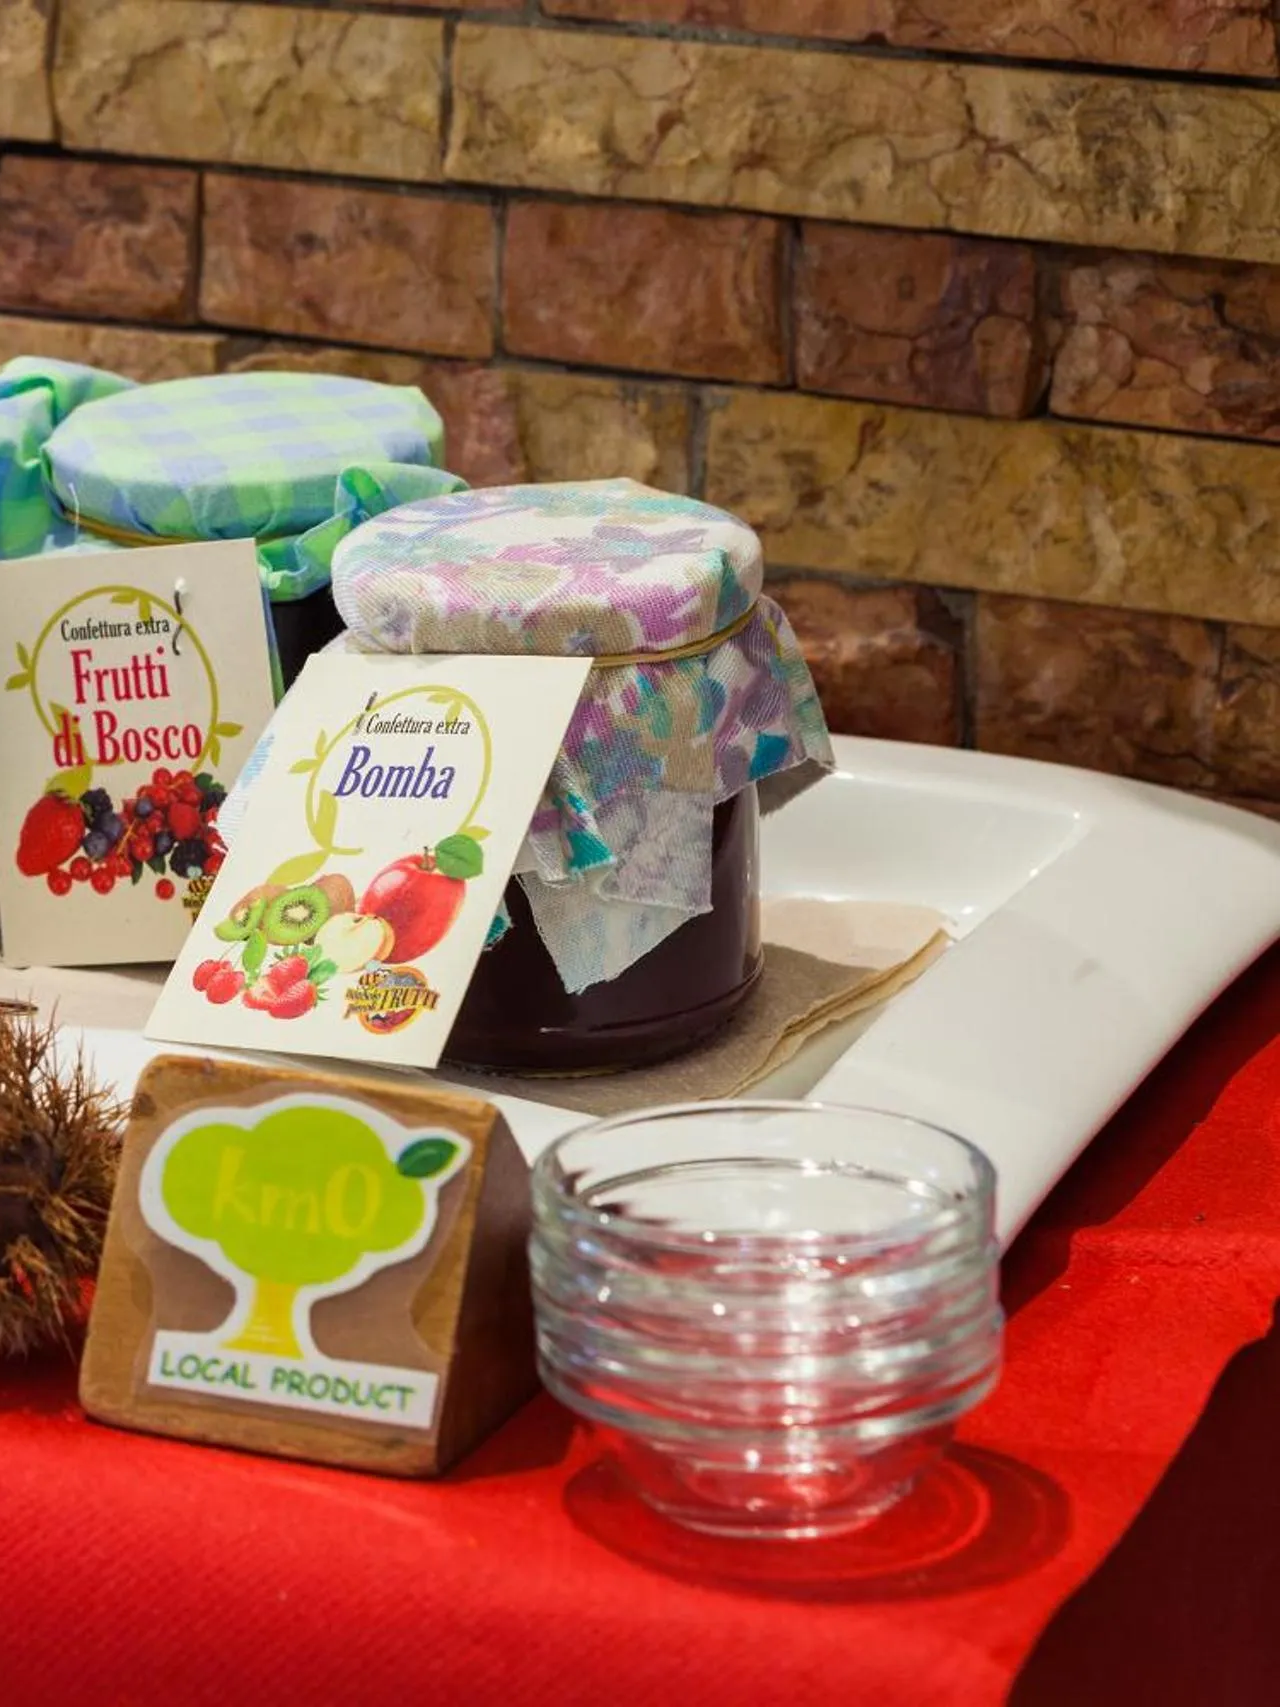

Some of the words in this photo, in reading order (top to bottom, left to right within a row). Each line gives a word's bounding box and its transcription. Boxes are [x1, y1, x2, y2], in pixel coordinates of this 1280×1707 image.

[60, 617, 132, 642] Confettura
[135, 616, 171, 635] extra
[69, 645, 170, 704] Frutti
[52, 708, 86, 768] di
[93, 709, 203, 766] Bosco
[366, 712, 434, 735] Confettura
[435, 716, 471, 735] extra
[332, 744, 457, 799] Bomba
[379, 986, 440, 1011] FRUTTI
[159, 1349, 256, 1390] LOCAL
[270, 1366, 416, 1412] PRODUCT
